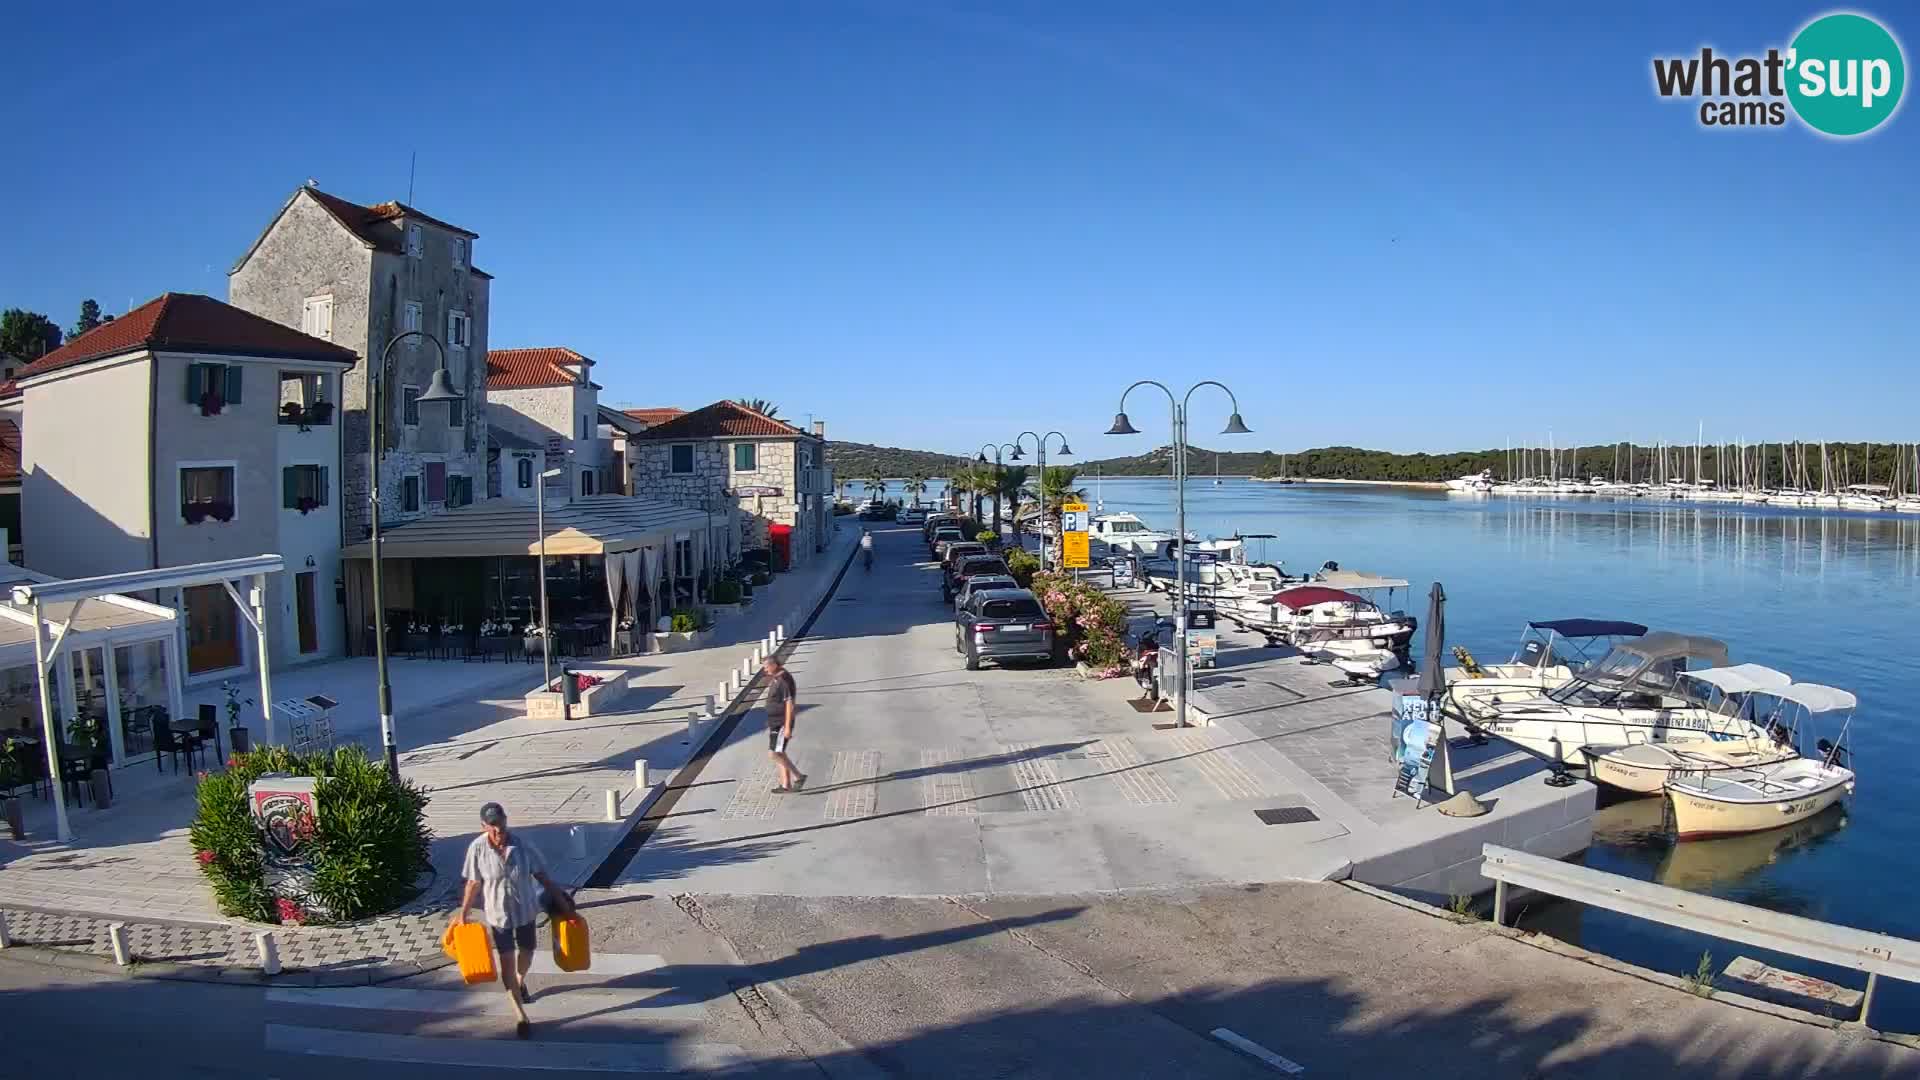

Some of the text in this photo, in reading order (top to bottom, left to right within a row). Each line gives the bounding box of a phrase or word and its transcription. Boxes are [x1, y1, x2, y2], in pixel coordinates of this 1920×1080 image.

[1065, 513, 1076, 531] P
[1665, 718, 1684, 728] RENT
[1685, 719, 1691, 728] A
[1692, 718, 1709, 731] BOAT
